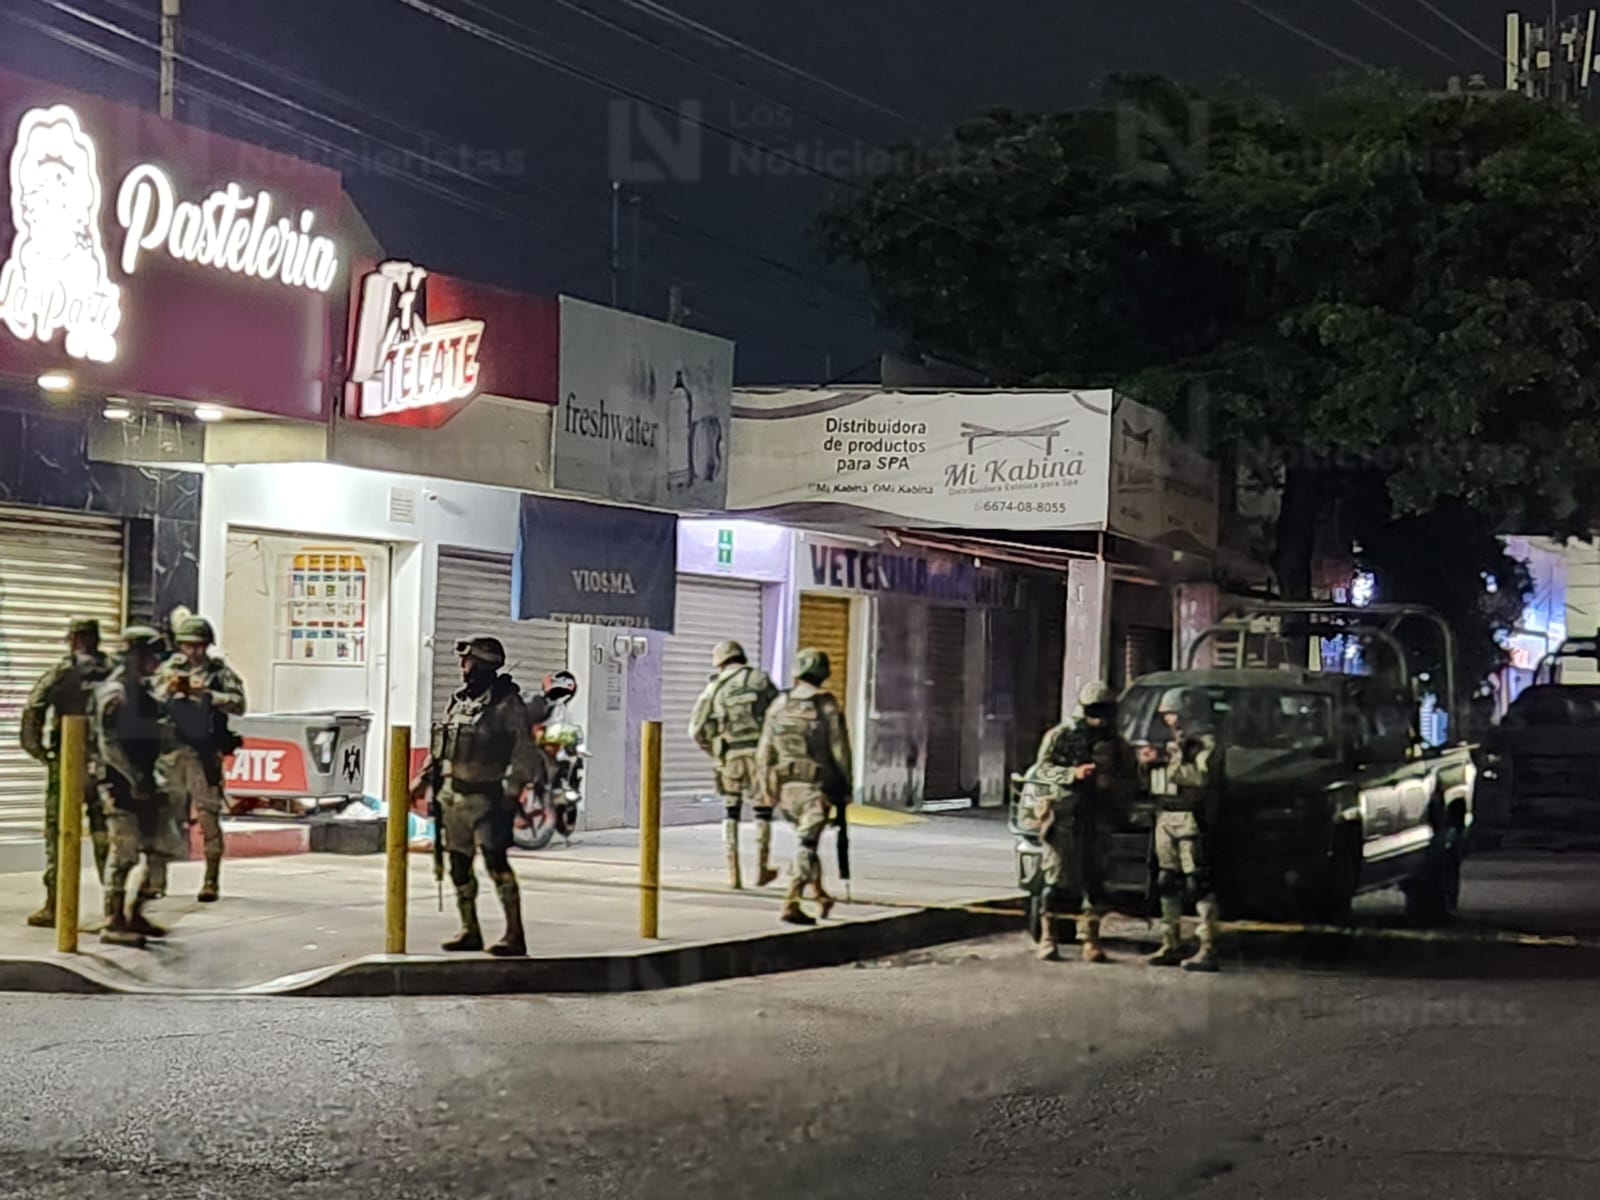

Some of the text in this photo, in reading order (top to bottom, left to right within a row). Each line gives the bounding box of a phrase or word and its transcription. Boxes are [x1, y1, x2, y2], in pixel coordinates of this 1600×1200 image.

[117, 164, 338, 292] Pasteleria
[382, 331, 481, 408] TECATE
[565, 391, 659, 448] freshwater
[825, 417, 928, 435] Distribuidora
[823, 436, 927, 455] de productos
[836, 456, 910, 473] para SPA
[944, 457, 1084, 487] Mi Kabina
[983, 500, 1067, 514] 6674-08-8055
